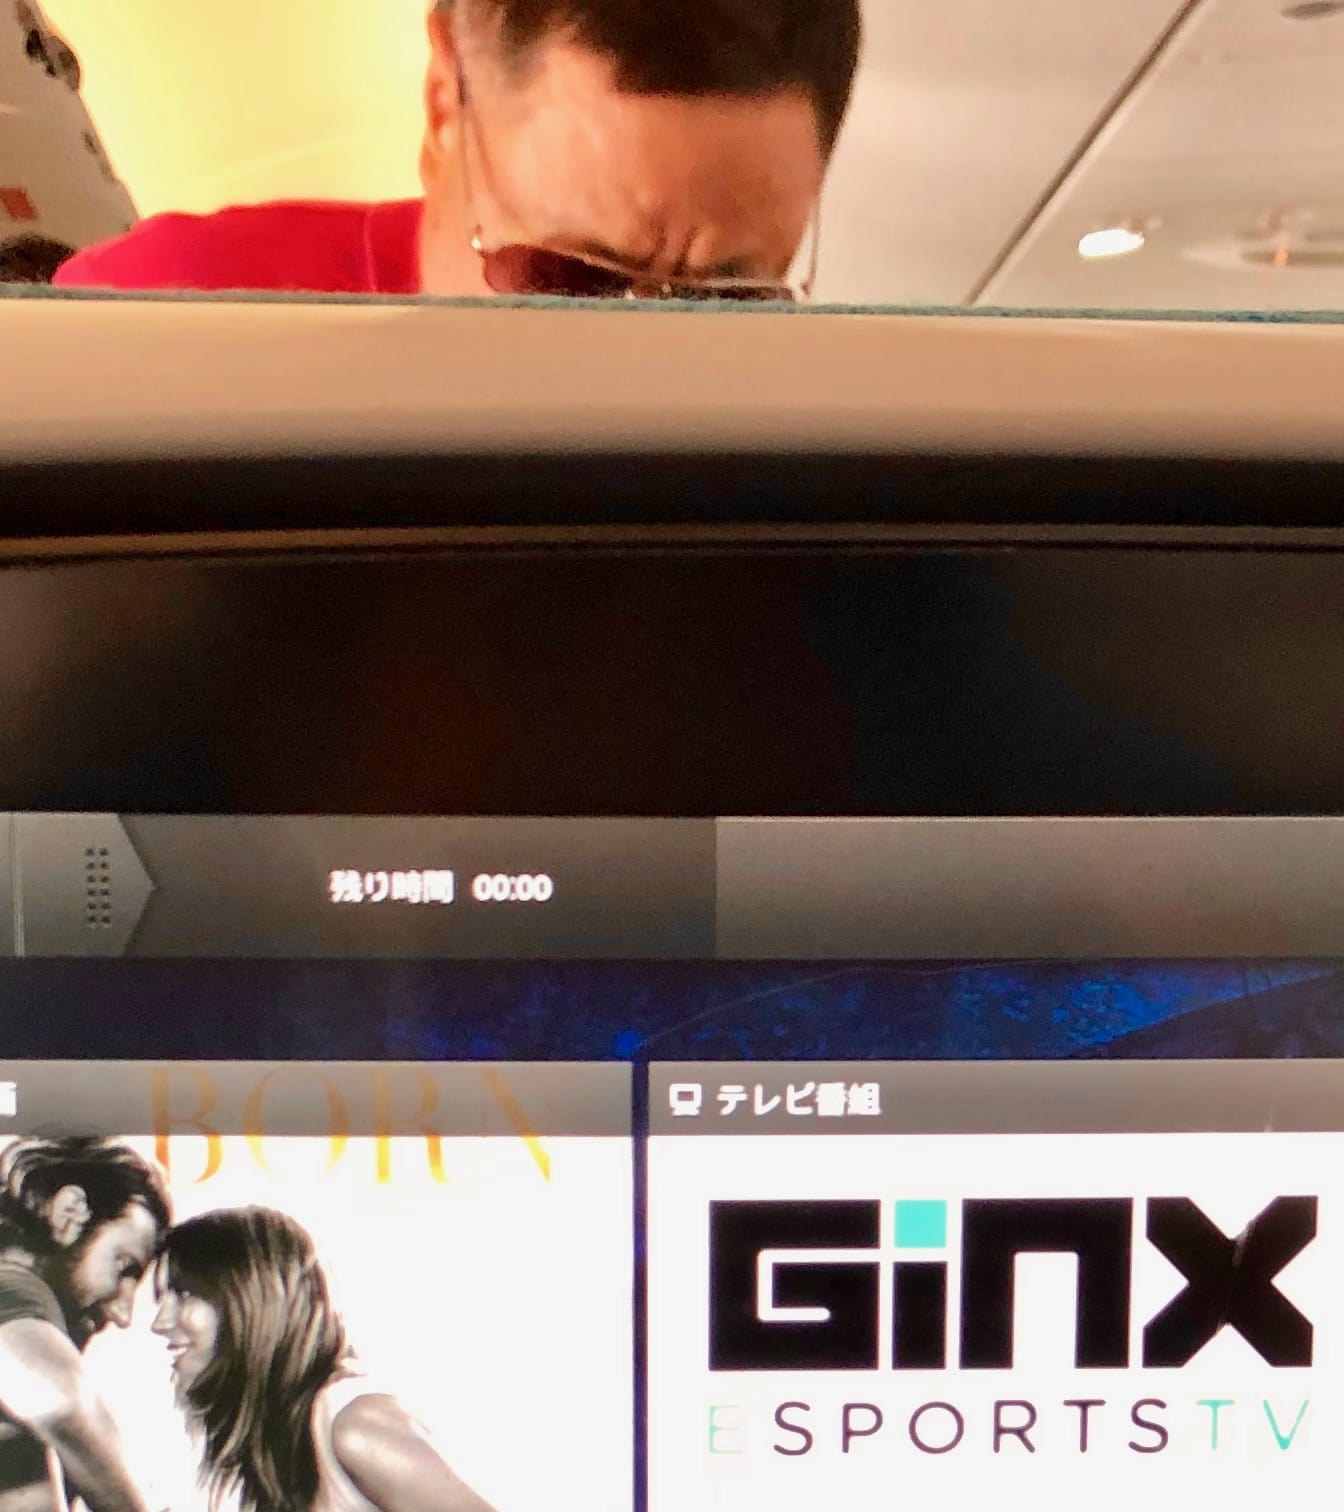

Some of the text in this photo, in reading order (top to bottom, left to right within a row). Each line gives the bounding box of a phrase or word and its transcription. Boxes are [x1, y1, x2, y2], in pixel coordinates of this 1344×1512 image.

[329, 869, 553, 903] 残り時間 00:00
[716, 1082, 882, 1117] テレビ番組
